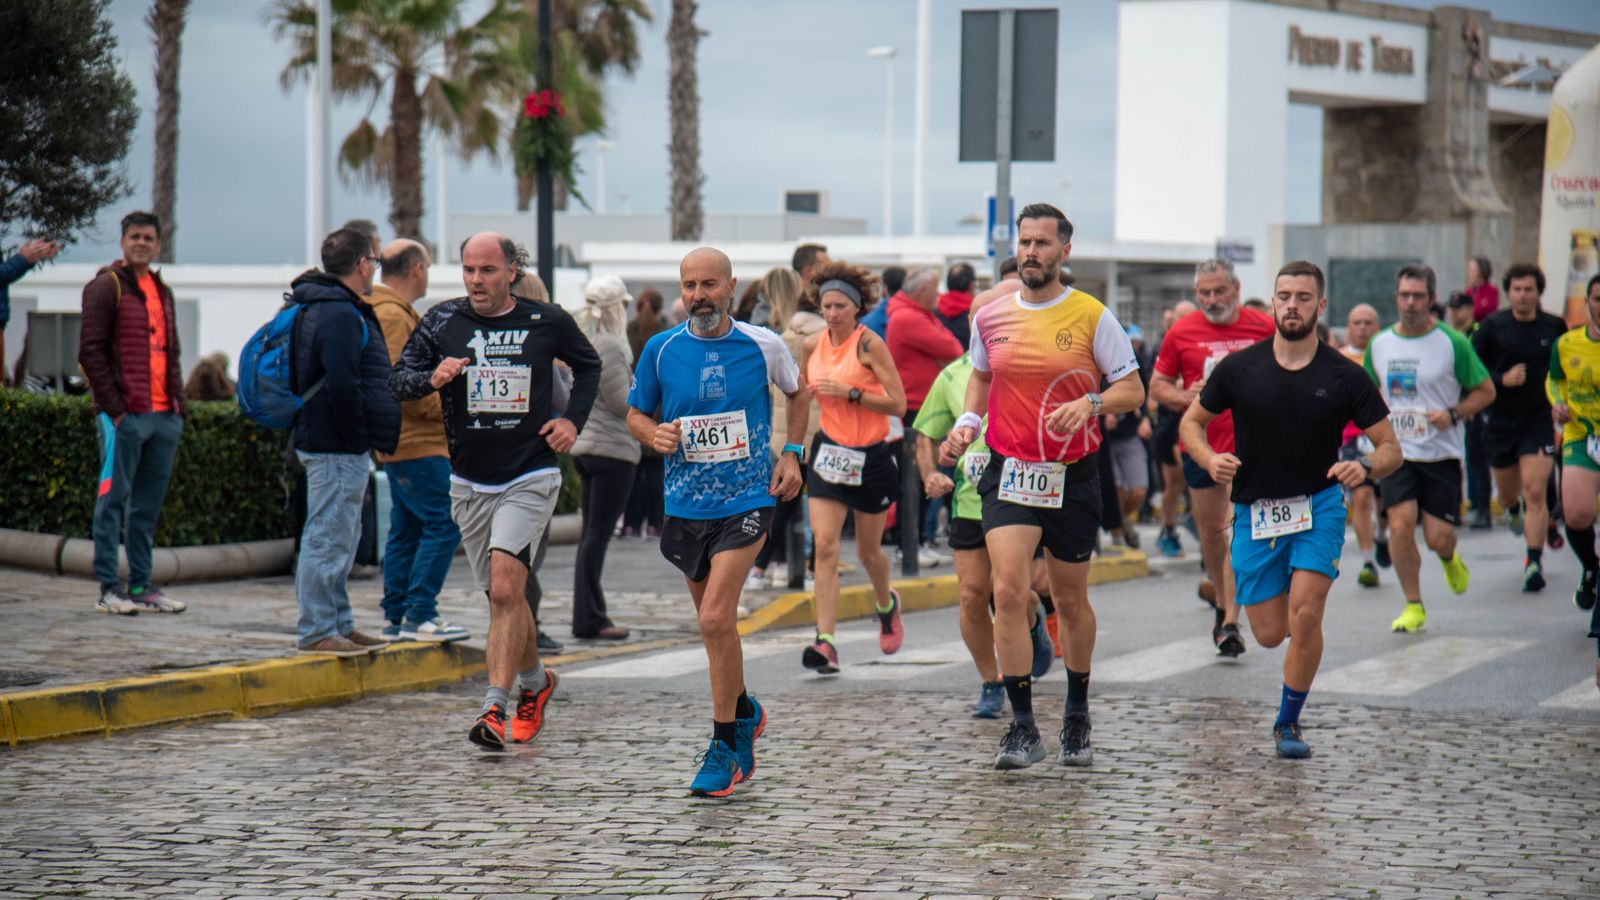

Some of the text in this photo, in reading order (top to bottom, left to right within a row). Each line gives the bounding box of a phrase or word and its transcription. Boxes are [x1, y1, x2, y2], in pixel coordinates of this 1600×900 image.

[488, 331, 529, 345] XIV
[479, 370, 497, 378] XIV
[489, 379, 509, 397] 13
[690, 418, 710, 429] XIV
[697, 426, 729, 447] 461
[828, 456, 850, 472] 462
[1014, 461, 1032, 471] XIV
[1018, 471, 1047, 491] 110
[1260, 499, 1276, 507] XIV
[1272, 505, 1291, 523] 58
